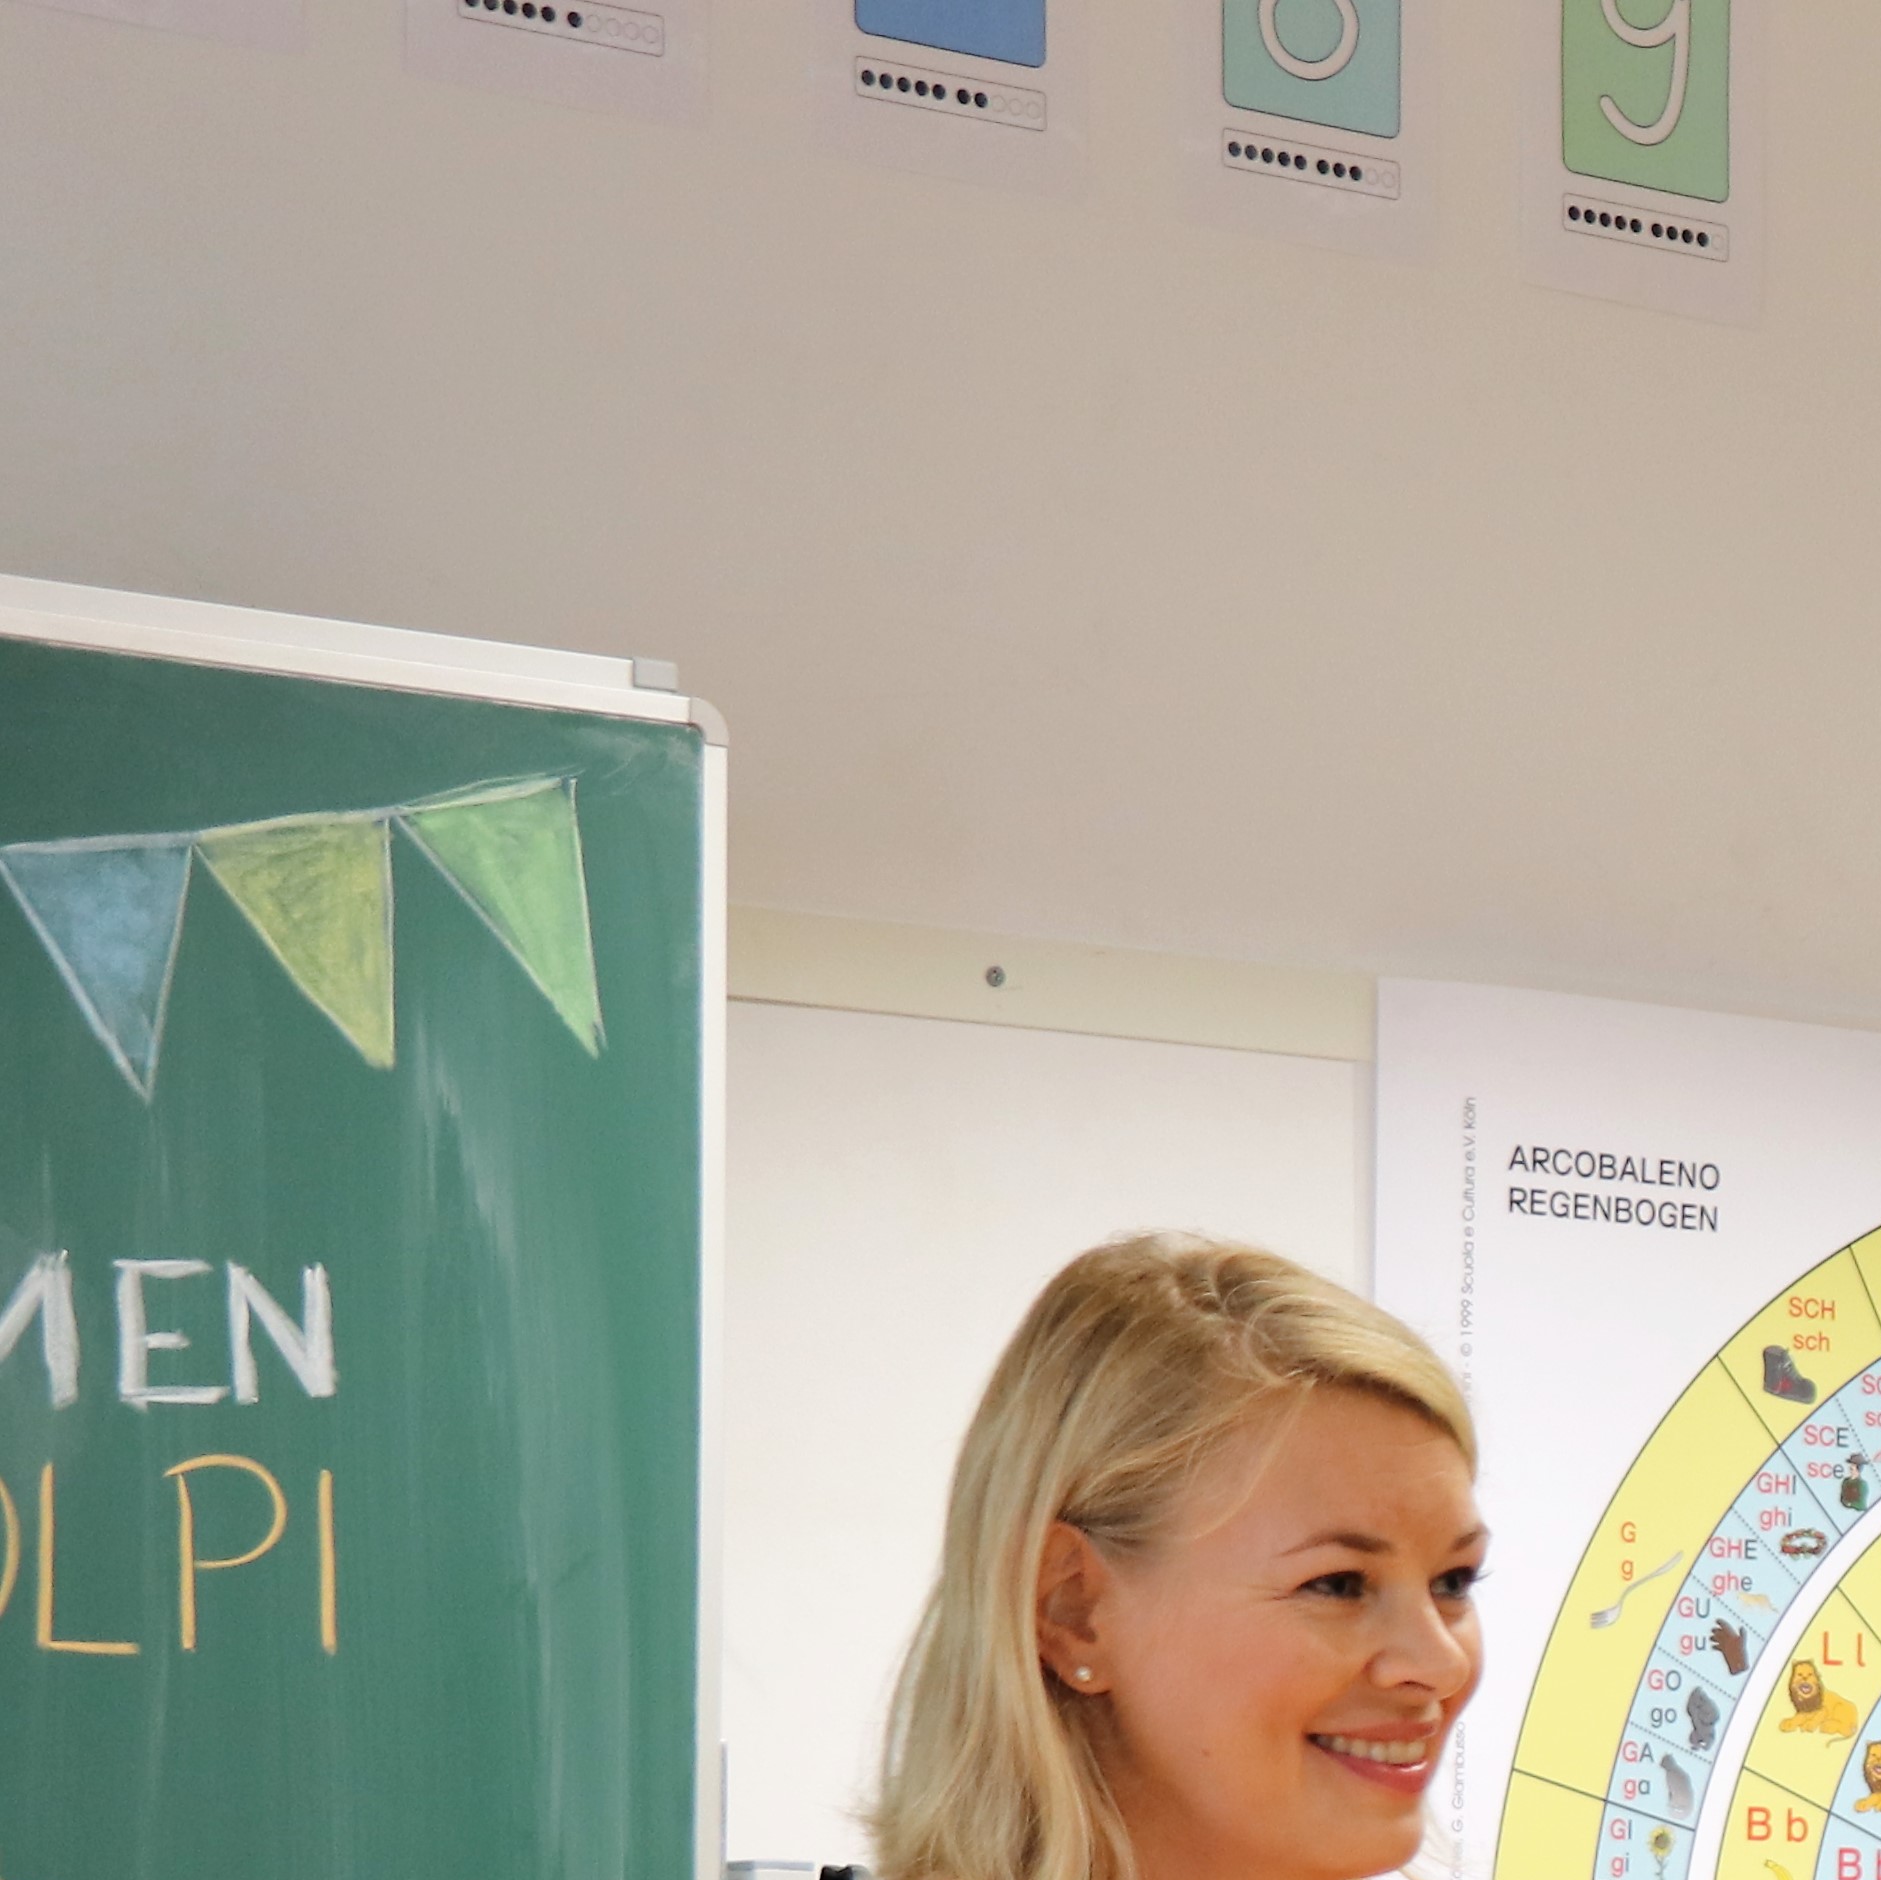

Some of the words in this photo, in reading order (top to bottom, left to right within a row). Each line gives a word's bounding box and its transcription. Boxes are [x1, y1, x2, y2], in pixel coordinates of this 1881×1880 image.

[1462, 1096, 1477, 1130] Köln
[1509, 1146, 1719, 1190] ARCOBALENO
[1462, 1166, 1476, 1222] Cultura
[1509, 1187, 1717, 1231] REGENBOGEN
[1461, 1242, 1475, 1295] Scuola
[1461, 1299, 1474, 1336] 1999
[1789, 1296, 1835, 1320] SCH
[1793, 1332, 1829, 1351] sch
[1804, 1425, 1849, 1448] SCE
[1807, 1459, 1844, 1479] sce
[1756, 1473, 1797, 1495] GHI
[1760, 1507, 1792, 1531] ghi
[1621, 1522, 1635, 1543] G
[0, 1454, 338, 1656] LPI
[1709, 1538, 1757, 1560] GHE
[1621, 1560, 1633, 1581] g
[1712, 1572, 1752, 1594] ghe
[1678, 1597, 1710, 1619] GU
[1680, 1635, 1706, 1655] gu
[1648, 1669, 1681, 1691] GO
[1651, 1708, 1677, 1728] go
[1623, 1741, 1654, 1762] GA
[1624, 1779, 1650, 1800] ga
[1610, 1819, 1632, 1840] GI
[1611, 1853, 1629, 1878] gi
